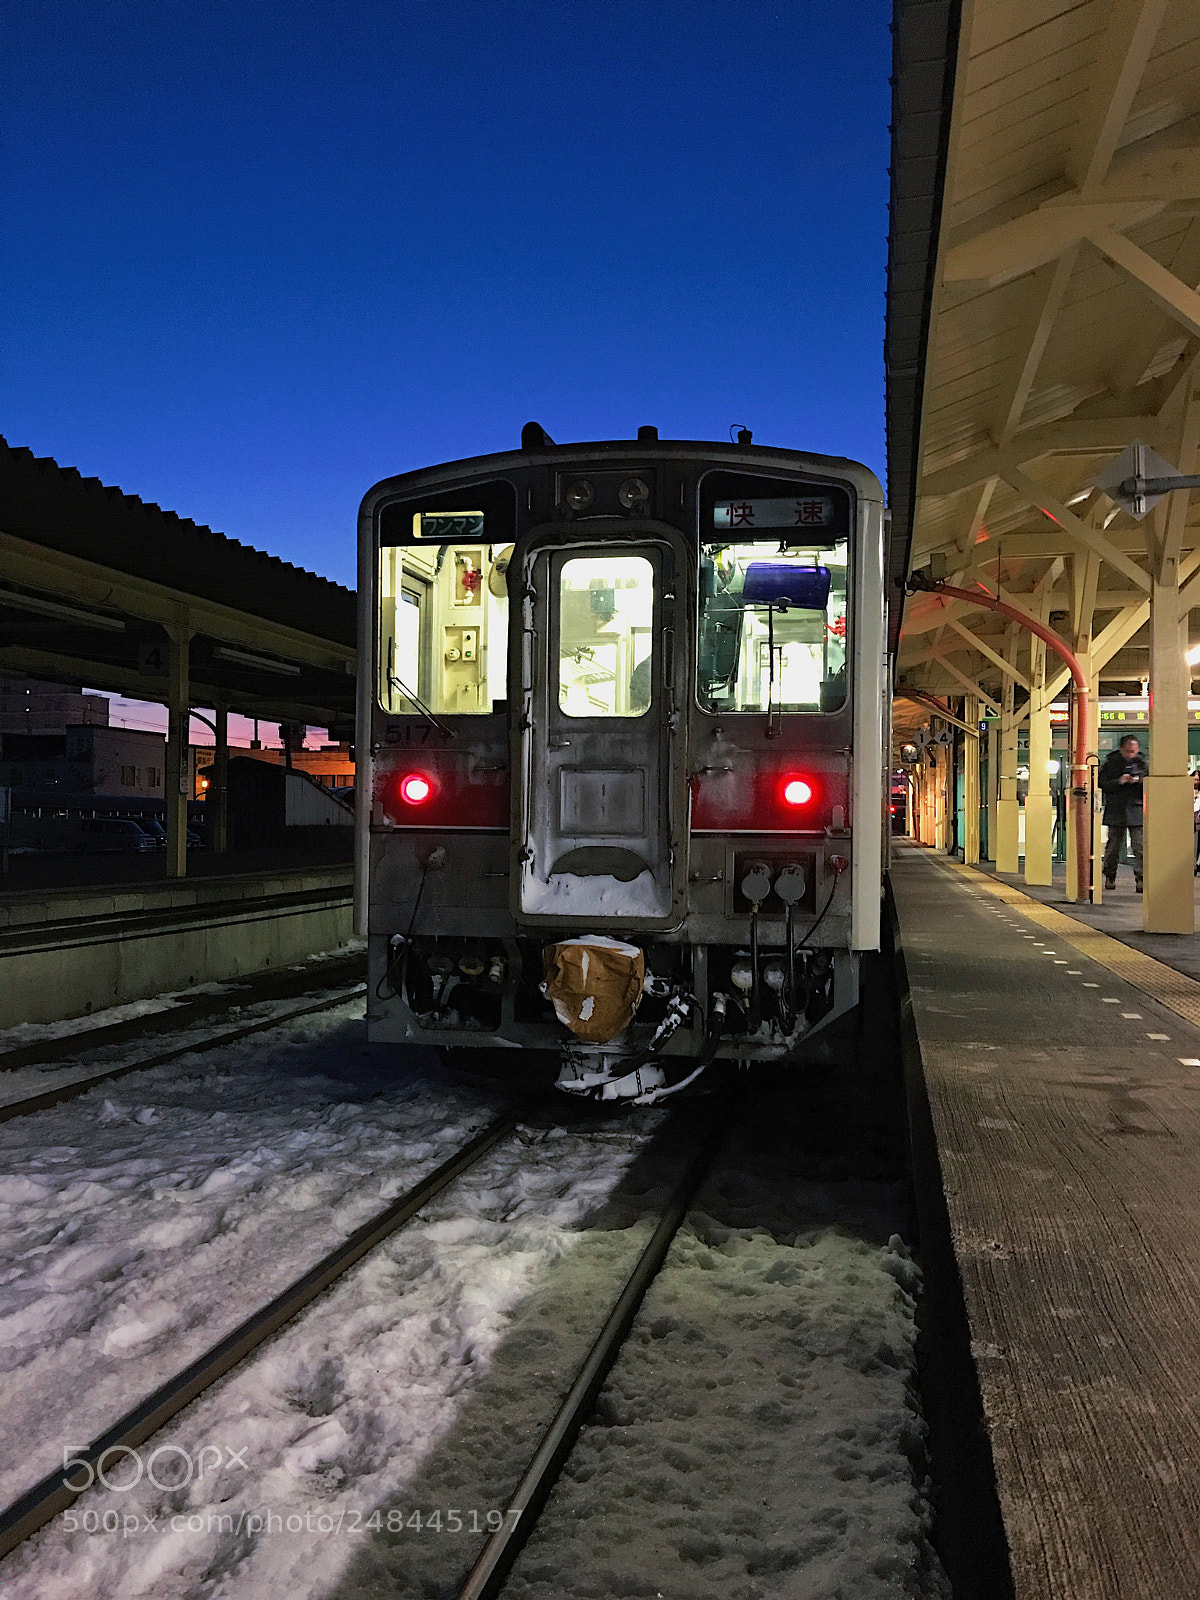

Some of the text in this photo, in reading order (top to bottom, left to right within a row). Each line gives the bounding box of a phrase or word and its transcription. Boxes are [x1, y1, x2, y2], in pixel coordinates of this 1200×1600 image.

[725, 500, 825, 528] 快速
[422, 517, 484, 535] ワンマン
[145, 648, 163, 669] 4
[980, 722, 986, 730] 9
[919, 733, 924, 743] 1
[940, 732, 949, 743] 4
